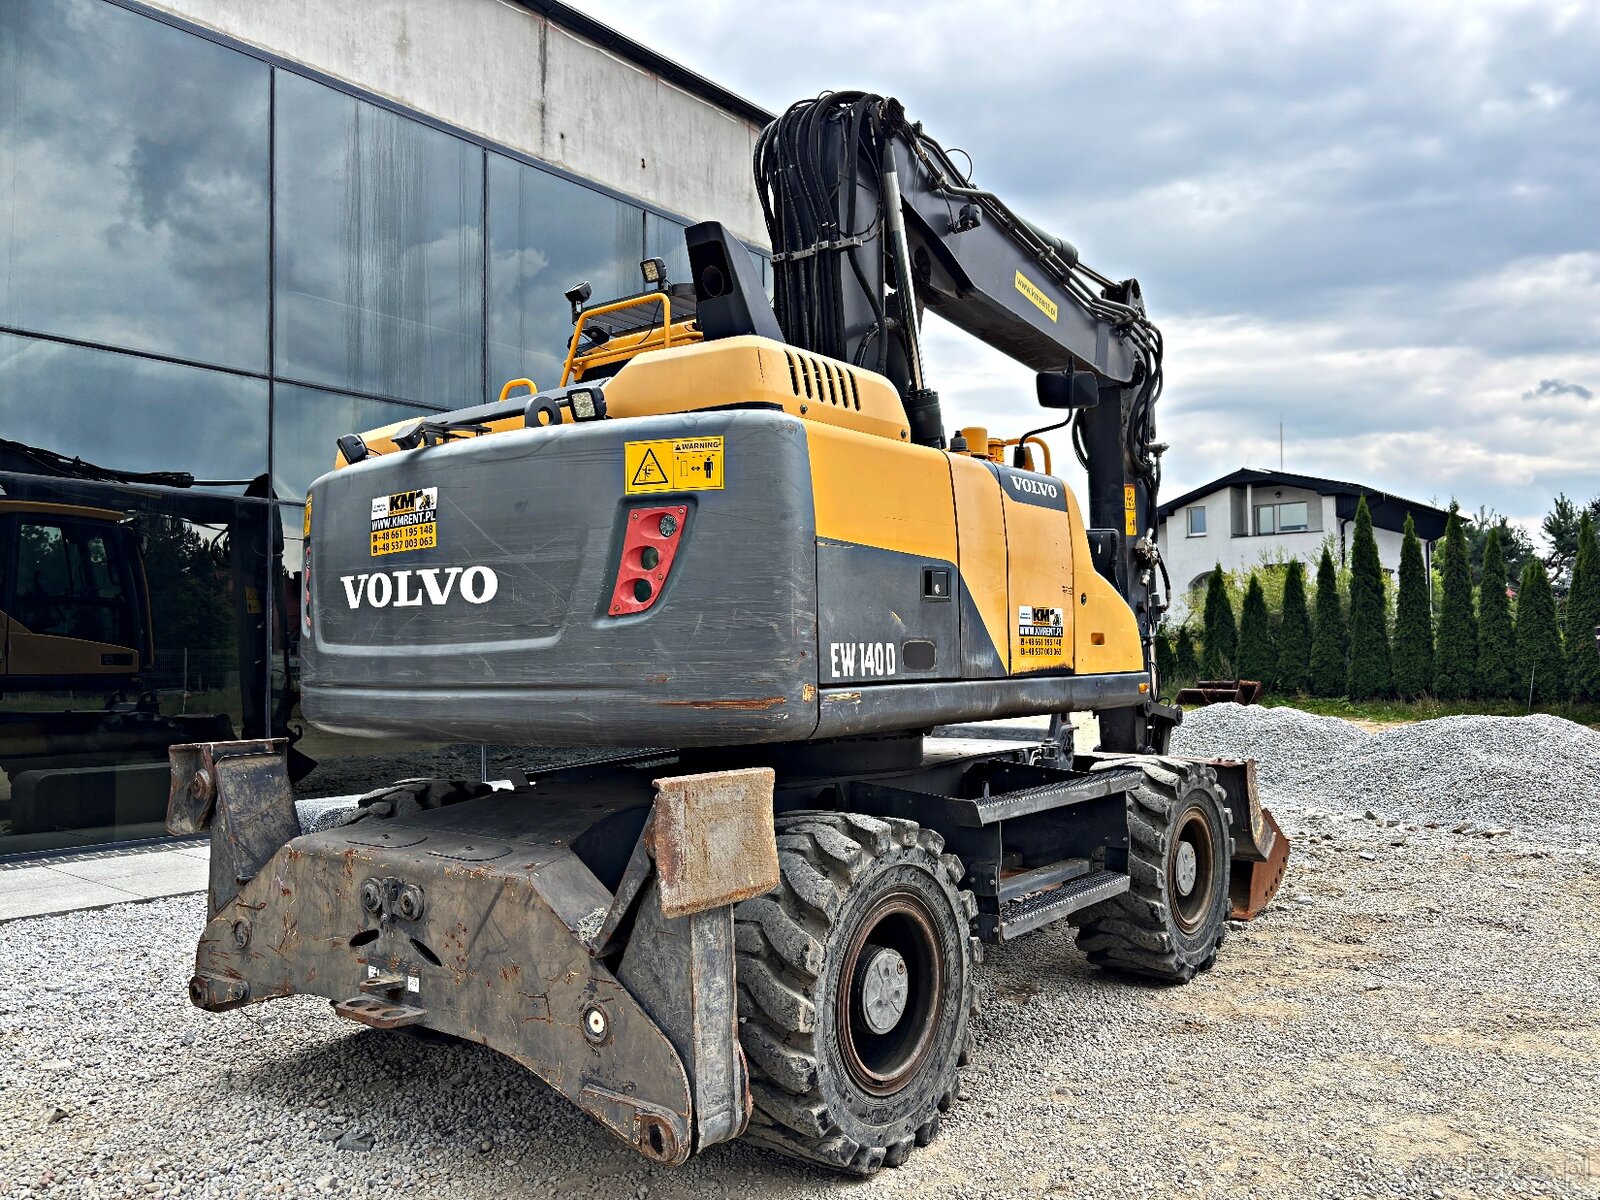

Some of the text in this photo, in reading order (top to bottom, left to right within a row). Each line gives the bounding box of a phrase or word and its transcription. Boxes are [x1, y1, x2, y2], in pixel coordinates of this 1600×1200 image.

[681, 441, 720, 450] WARNING
[1010, 474, 1058, 499] VOLVO
[389, 492, 415, 511] KM
[371, 511, 436, 532] WWW.KMRENT.PL
[405, 527, 417, 537] 195
[420, 525, 433, 535] 148
[340, 565, 499, 610] VOLVO
[830, 643, 856, 678] EW
